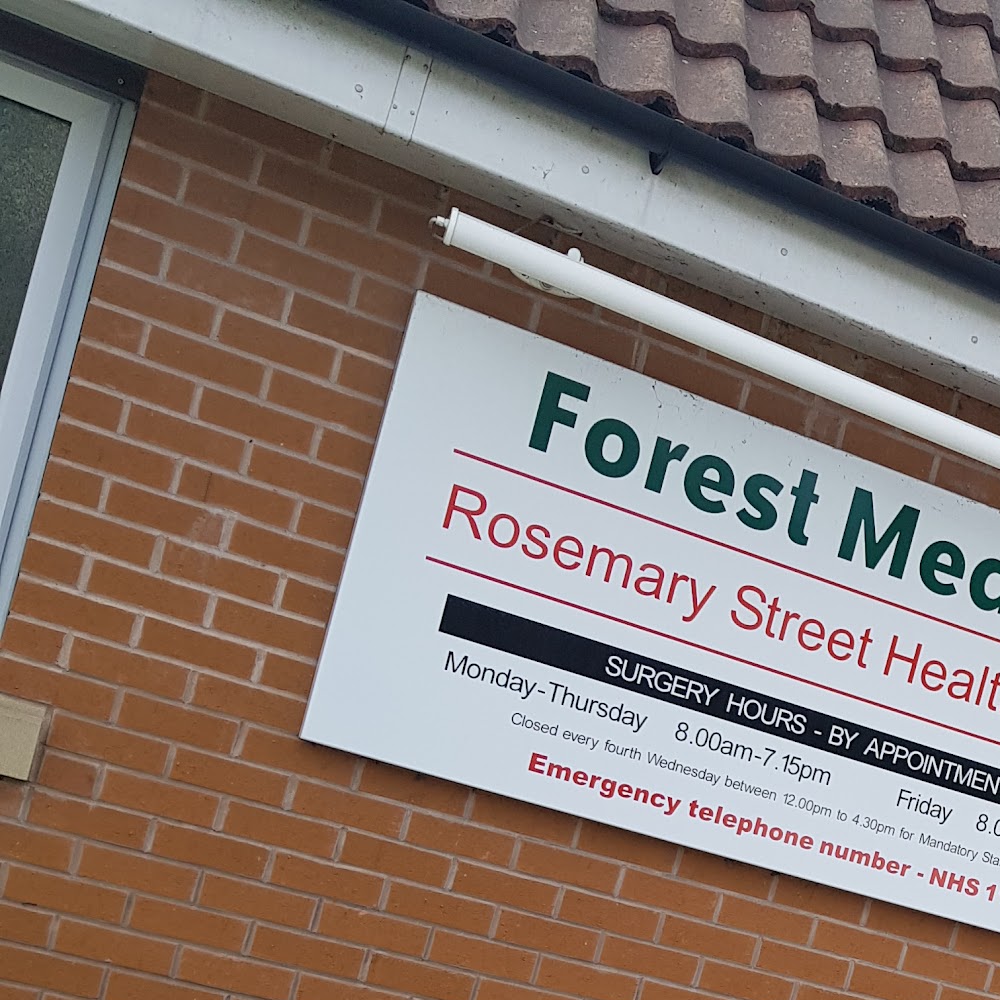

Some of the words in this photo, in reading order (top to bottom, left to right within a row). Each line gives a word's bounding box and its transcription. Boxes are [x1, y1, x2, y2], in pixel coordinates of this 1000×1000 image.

[528, 371, 820, 546] Forest
[442, 483, 717, 622] Rosemary
[730, 584, 873, 669] Street
[443, 651, 648, 733] Monday-Thursday
[674, 721, 832, 786] 8.00am-7.15pm
[896, 788, 953, 825] Friday
[604, 655, 720, 707] SURGERY
[725, 687, 807, 735] HOURS
[828, 725, 859, 751] BY
[511, 712, 558, 738] Closed
[562, 730, 599, 751] every
[604, 738, 642, 762] fourth
[646, 752, 722, 786] Wednesday
[725, 774, 777, 802] between
[783, 793, 832, 820] 12.00pm
[836, 807, 848, 822] to
[852, 813, 896, 837] 4.30pm
[899, 827, 915, 842] for
[918, 832, 978, 863] Mandatory
[527, 751, 681, 816] Emergency
[688, 798, 814, 851] telephone
[818, 840, 912, 878] number
[929, 867, 980, 897] NHS
